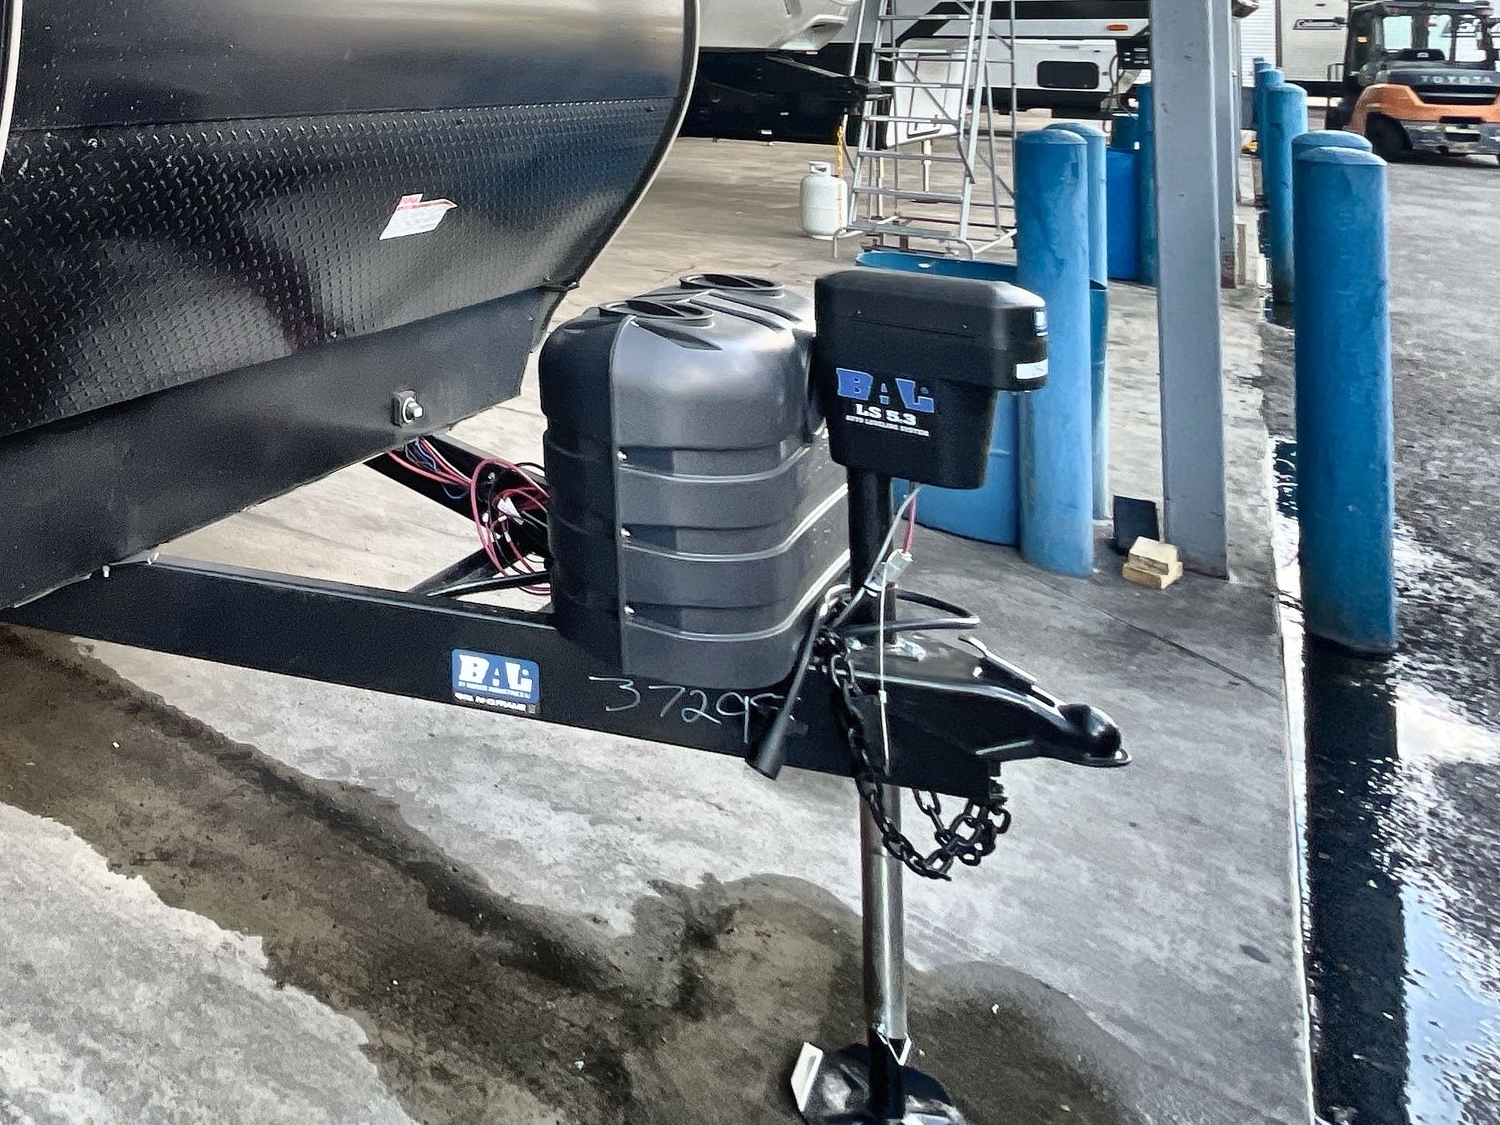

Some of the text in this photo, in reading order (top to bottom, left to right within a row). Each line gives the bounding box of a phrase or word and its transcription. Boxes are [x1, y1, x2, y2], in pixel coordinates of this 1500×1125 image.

[1420, 76, 1492, 84] TOYOTA
[836, 367, 935, 414] BAL
[855, 403, 917, 426] LS 5.3
[458, 654, 533, 693] BAL
